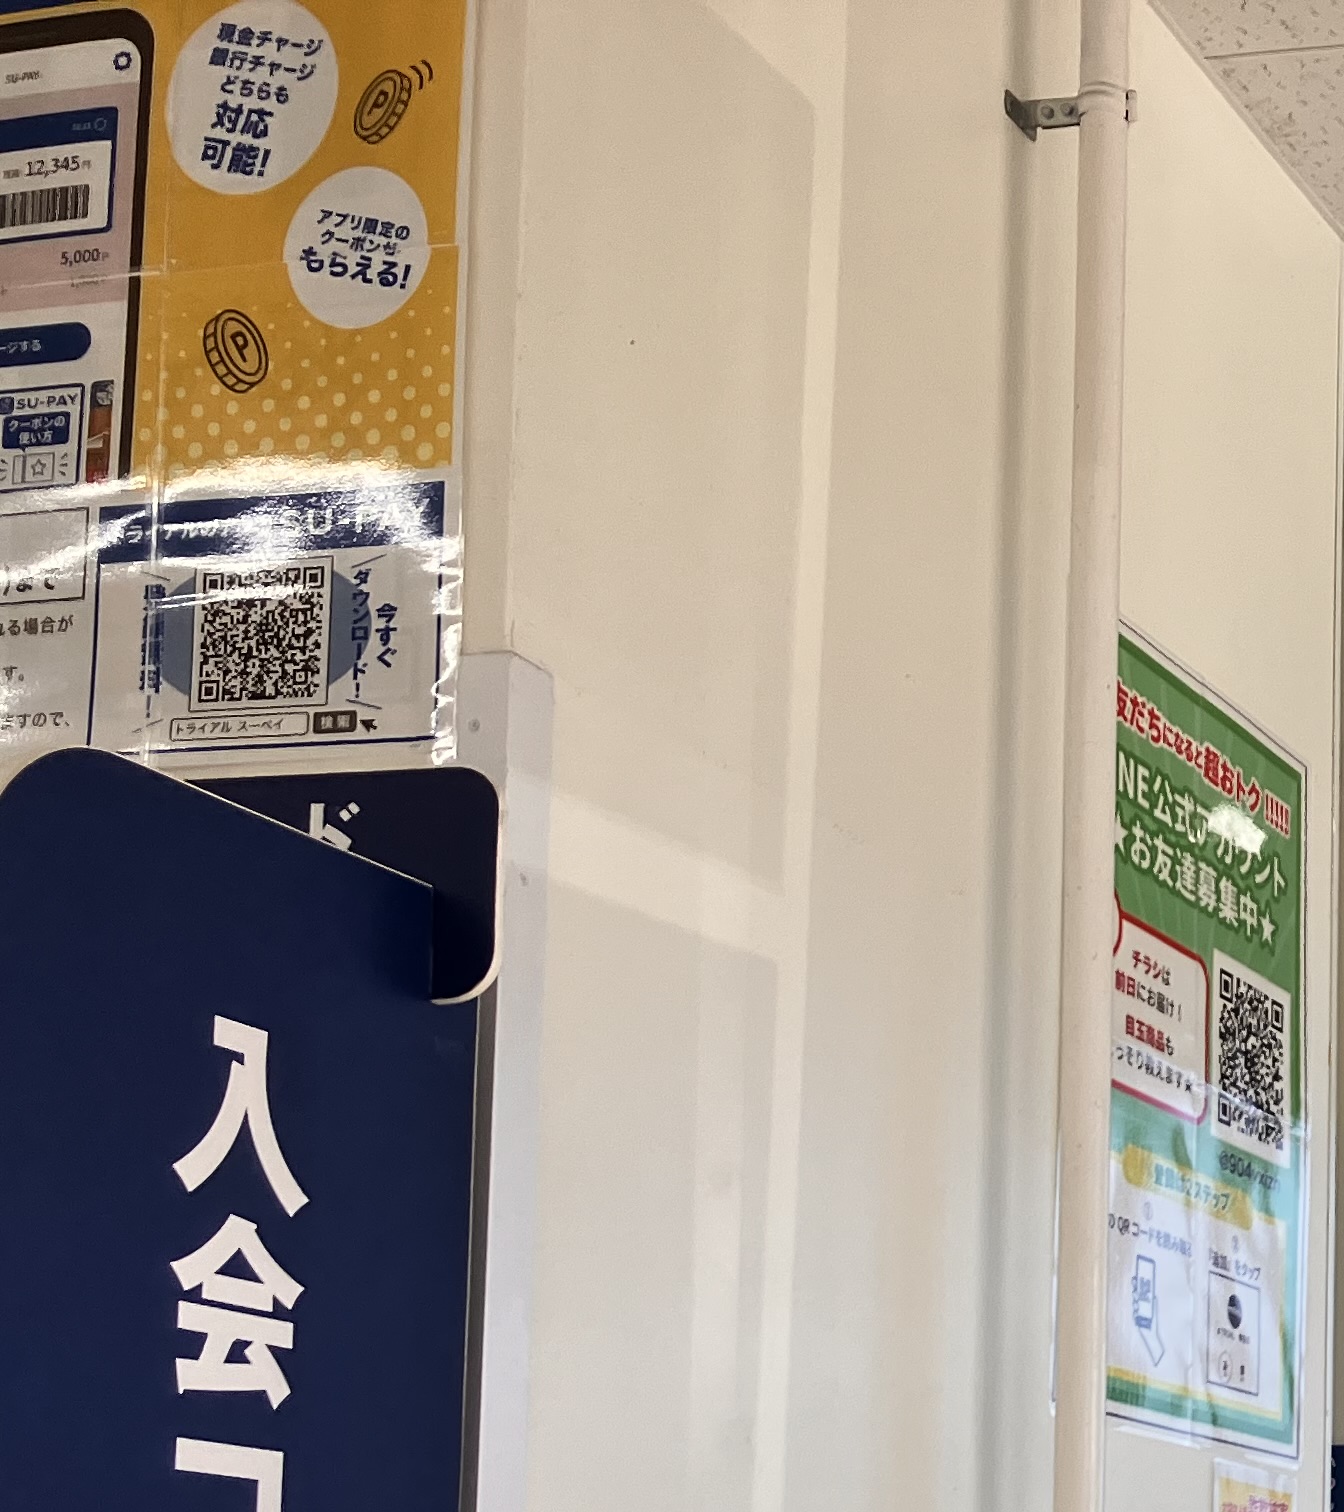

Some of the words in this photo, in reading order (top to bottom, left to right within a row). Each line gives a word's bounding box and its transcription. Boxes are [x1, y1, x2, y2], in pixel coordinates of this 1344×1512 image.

[217, 22, 324, 57] 現金チャージ
[209, 46, 317, 81] 銀行チャージ
[220, 74, 289, 104] どちらも
[211, 100, 274, 139] 対応
[201, 136, 271, 177] 可能!
[317, 208, 410, 240] アプリ限定の
[300, 246, 411, 289] もらえる!
[15, 393, 78, 410] SU-PAY
[9, 415, 66, 432] クーポンの
[19, 430, 54, 445] 使い方
[351, 568, 372, 698] ダウンロード!
[375, 603, 398, 668] 今すぐ
[176, 720, 231, 736] トライアル
[1131, 949, 1171, 986] チラシは
